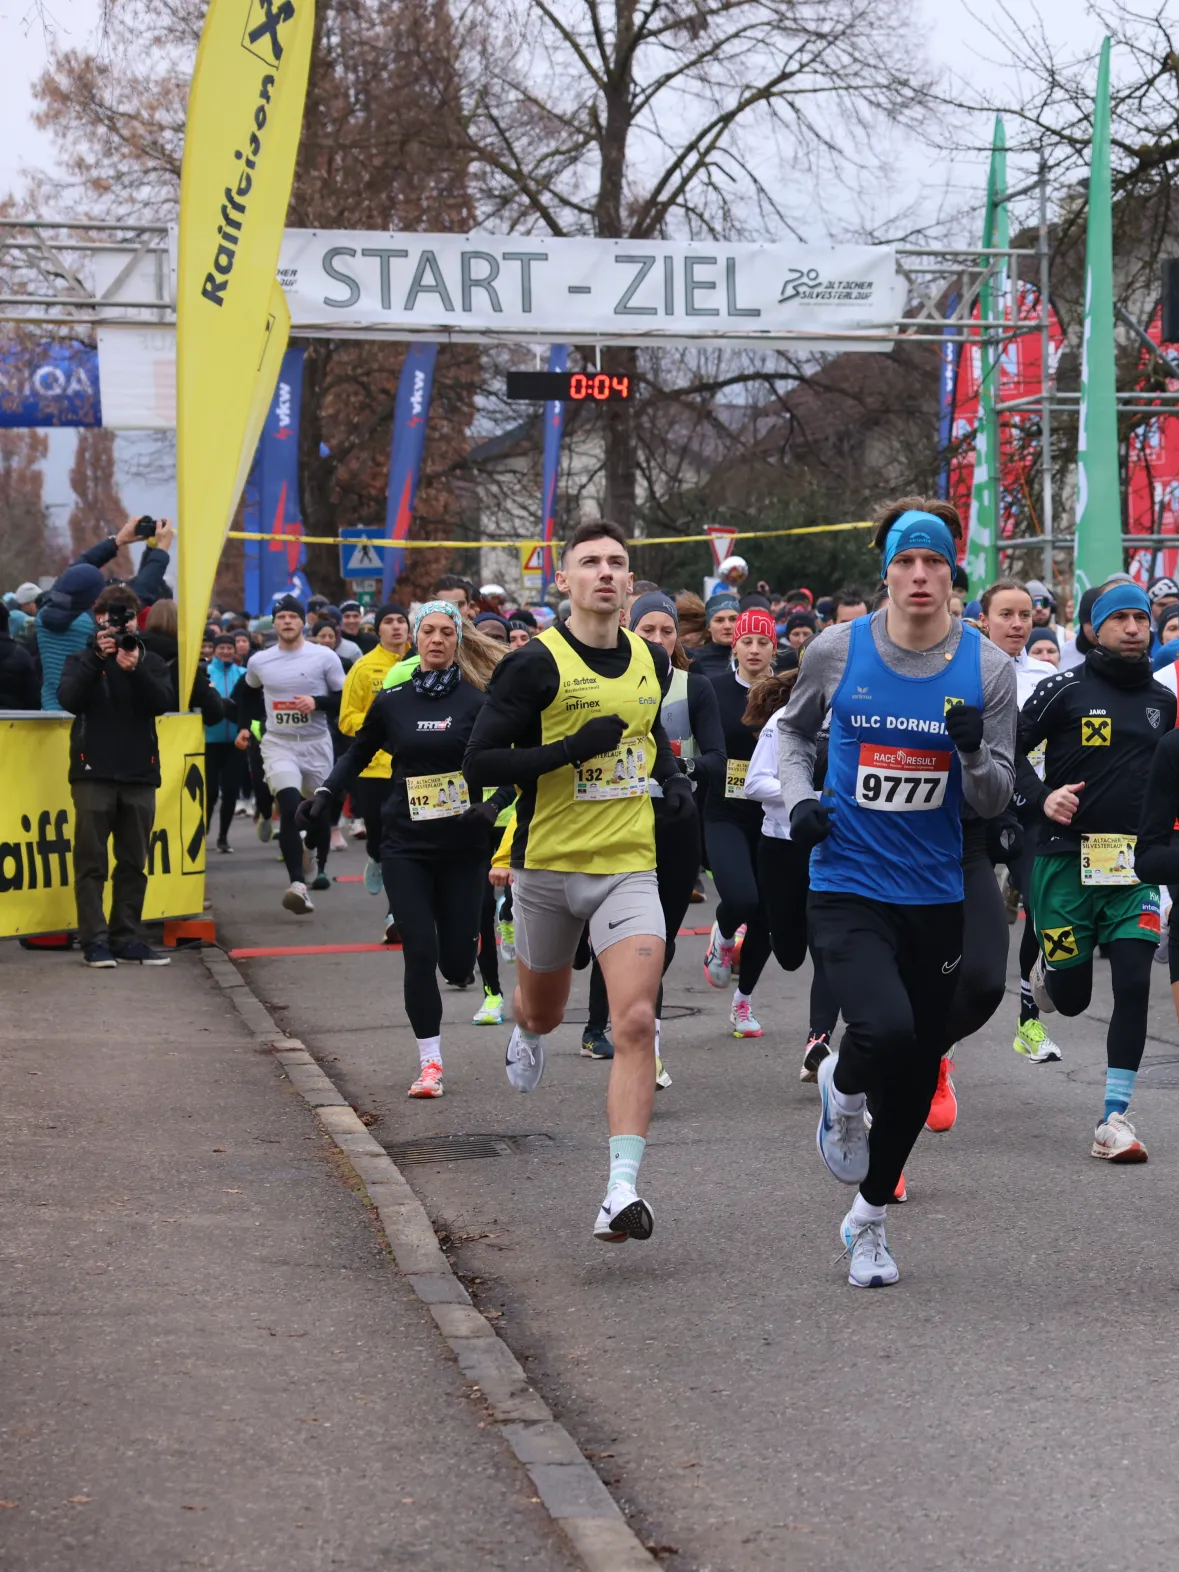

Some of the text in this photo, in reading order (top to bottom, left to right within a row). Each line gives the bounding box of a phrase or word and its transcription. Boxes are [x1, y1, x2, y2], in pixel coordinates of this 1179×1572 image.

[201, 74, 275, 307] Raiffeisen
[322, 247, 549, 313] START
[614, 254, 761, 317] ZIEL
[823, 281, 873, 290] ALTACHER
[800, 291, 873, 300] SILVESTERLAUF
[410, 370, 425, 415] vkw
[570, 374, 628, 399] 0:04
[276, 382, 292, 427] vkw
[565, 699, 600, 711] infinex
[275, 713, 309, 725] 9768
[851, 715, 949, 735] ULC DORNBI
[873, 752, 937, 766] RACE RESULT
[576, 768, 603, 782] 132
[727, 776, 745, 786] 229
[862, 773, 941, 804] 9777
[410, 795, 430, 807] 412
[1082, 857, 1091, 869] 3
